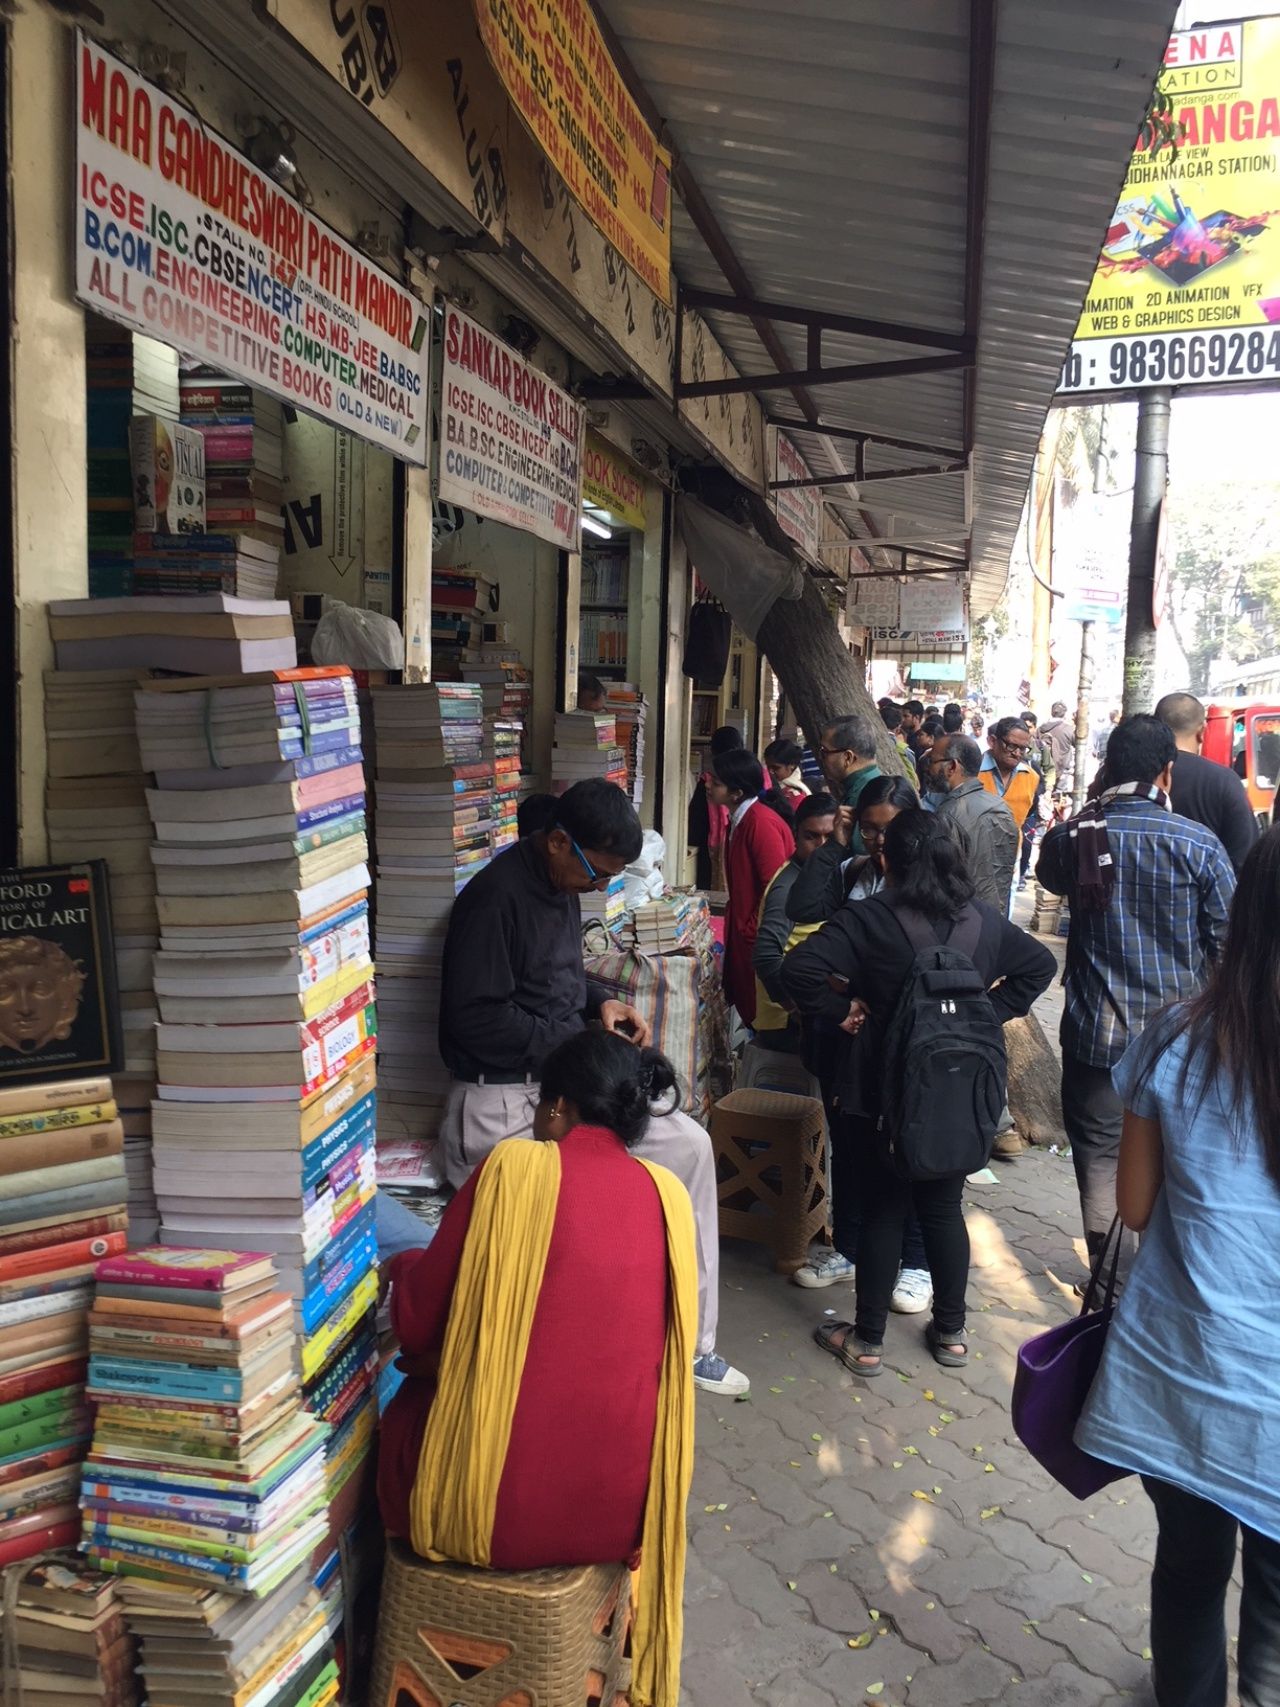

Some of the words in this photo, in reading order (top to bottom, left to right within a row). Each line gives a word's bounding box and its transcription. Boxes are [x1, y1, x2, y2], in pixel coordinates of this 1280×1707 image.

[1186, 146, 1210, 160] VIEW
[1218, 154, 1277, 176] STATION)
[82, 46, 152, 171] MAA
[158, 104, 304, 271] GANDHESWARI
[307, 219, 353, 306] PATH
[355, 260, 413, 350] MANDIR
[203, 213, 244, 252] STALL
[1146, 291, 1162, 307] 2D
[1166, 286, 1230, 306] ANIMATION
[1243, 283, 1263, 297] VFX
[1091, 315, 1118, 331] WEB
[1122, 313, 1131, 329] &
[1135, 309, 1193, 327] GRAPHICS
[1198, 305, 1241, 322] DESIGN
[89, 256, 137, 314] ALL
[143, 285, 279, 381] COMPETITIVE
[282, 357, 332, 410] BOOKS
[365, 406, 372, 425] &
[447, 312, 511, 402] SANKAR
[513, 360, 546, 421] BOOK
[548, 388, 578, 446] SELLER
[360, 369, 414, 419] MEDICAL
[338, 449, 347, 469] within
[498, 441, 555, 492] ENGINEERING
[584, 447, 610, 488] OOK
[446, 449, 501, 495] COMPUTER
[508, 478, 555, 521] COMPETITIVE
[337, 485, 347, 518] protective
[336, 530, 346, 557] Remove
[51, 907, 89, 926] ART
[321, 1119, 348, 1149] PHYSICS
[95, 1369, 161, 1386] Shakespeare
[199, 1511, 228, 1527] Story
[177, 1553, 186, 1564] A
[187, 1555, 217, 1572] Story
